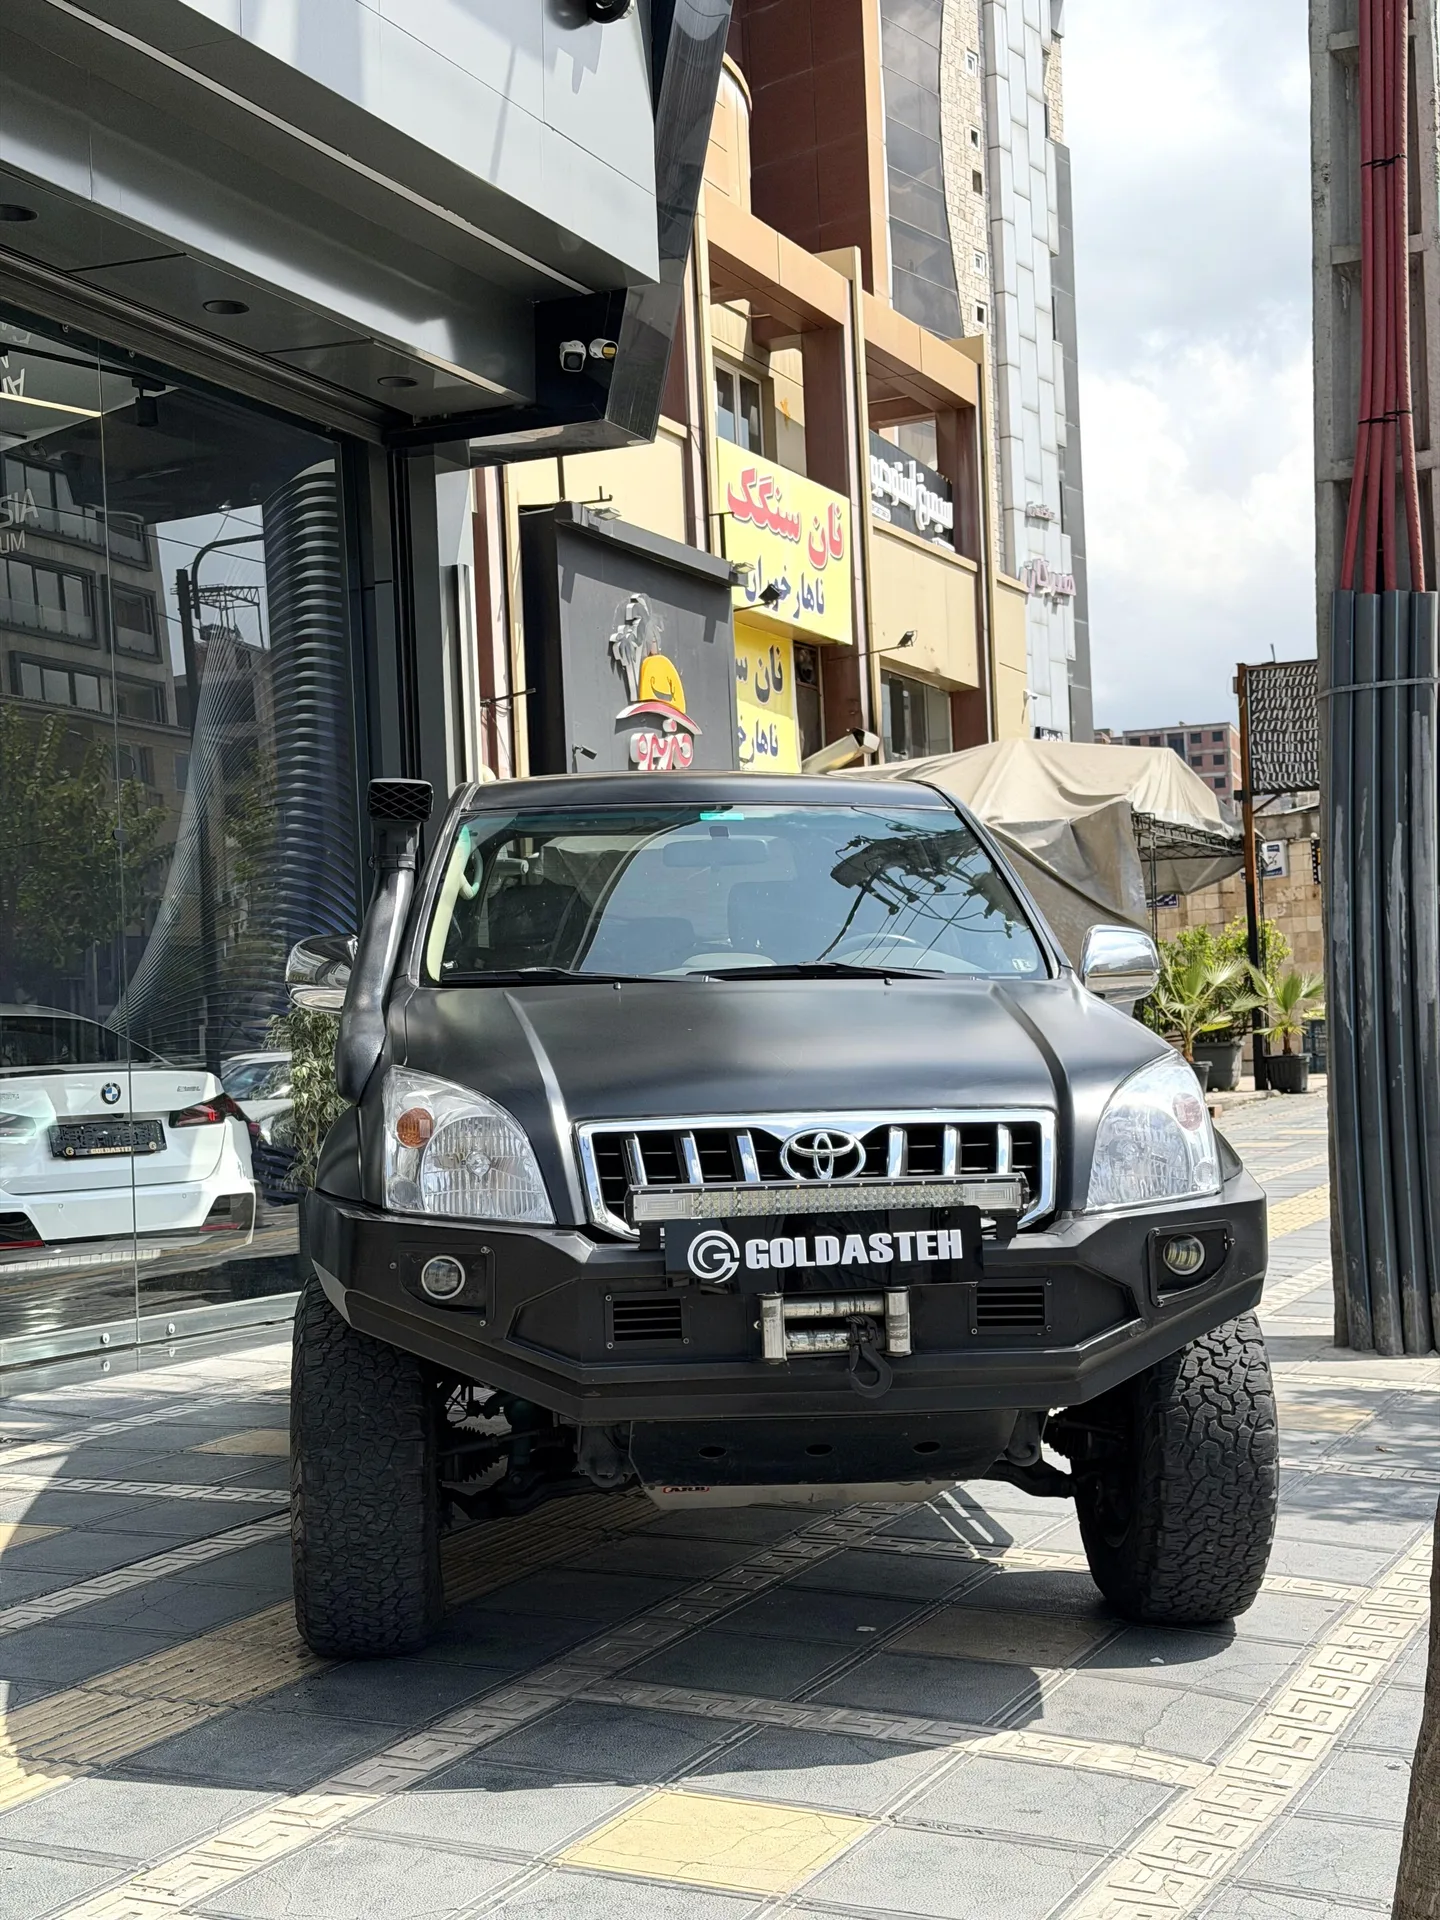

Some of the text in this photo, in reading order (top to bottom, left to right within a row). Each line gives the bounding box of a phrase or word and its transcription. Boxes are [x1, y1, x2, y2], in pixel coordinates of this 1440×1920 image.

[727, 467, 845, 571] نان سنگک
[792, 572, 825, 620] ناهار
[754, 643, 784, 704] نان
[748, 718, 779, 764] ناهار
[745, 1229, 964, 1270] GOLDASTEH
